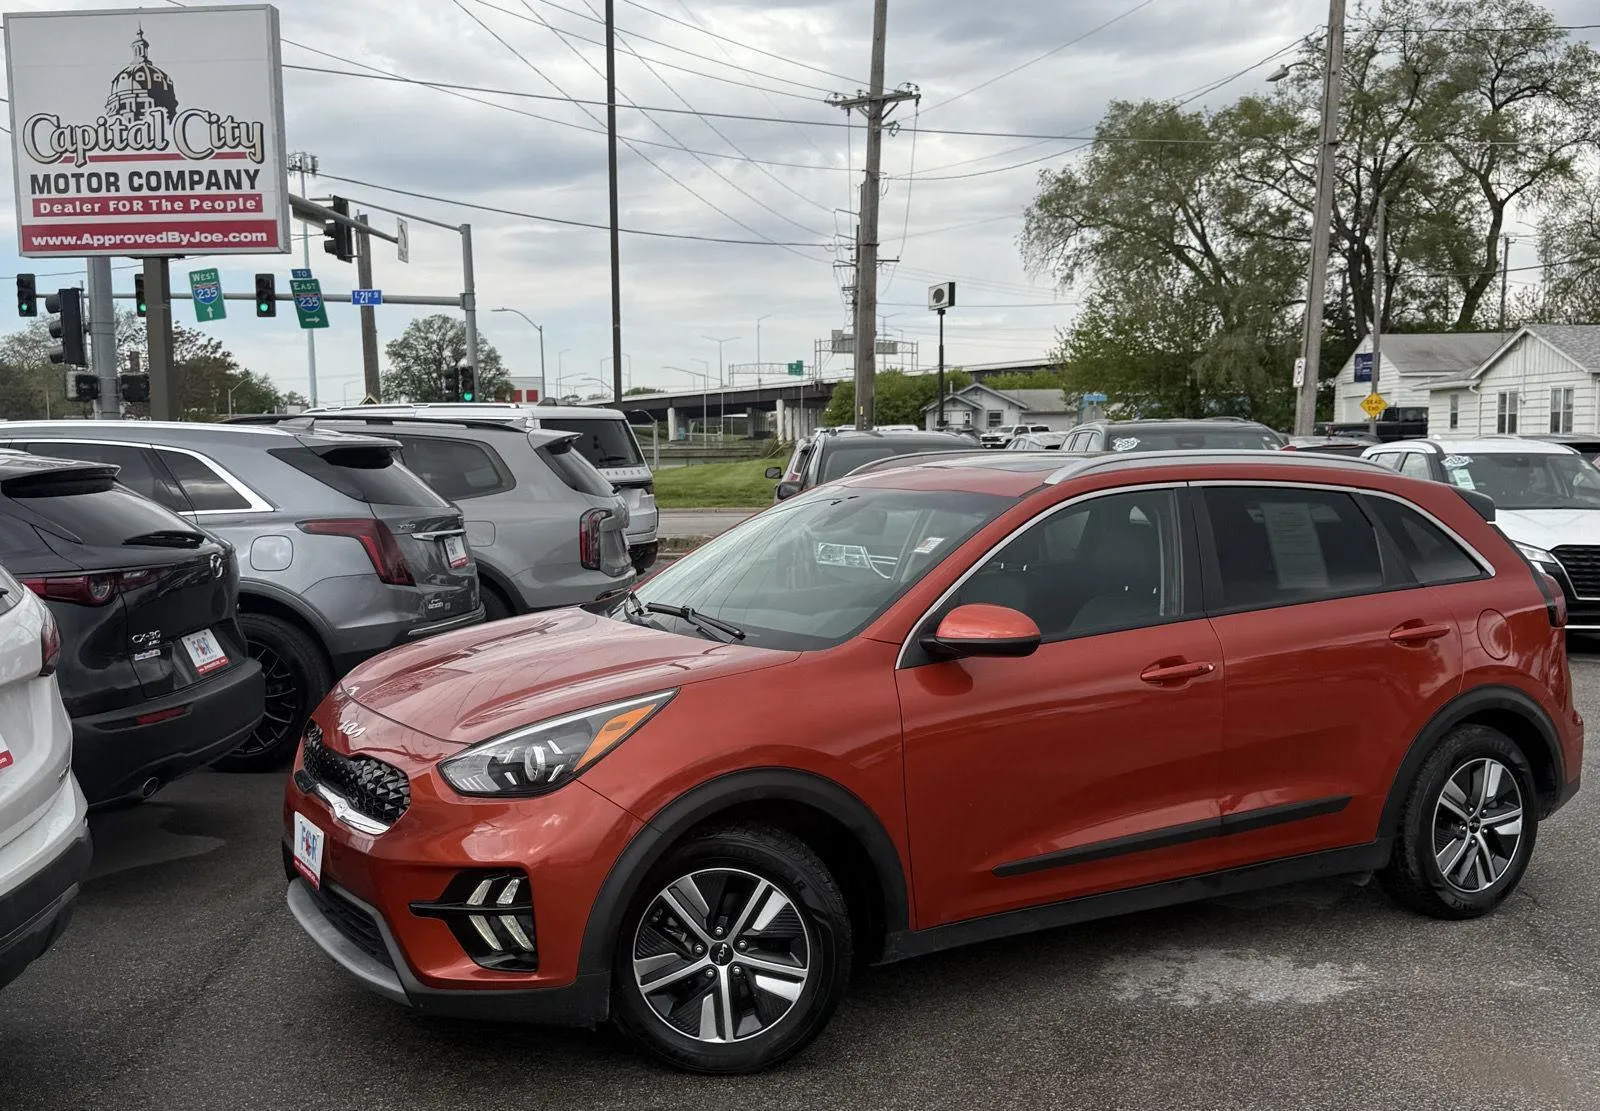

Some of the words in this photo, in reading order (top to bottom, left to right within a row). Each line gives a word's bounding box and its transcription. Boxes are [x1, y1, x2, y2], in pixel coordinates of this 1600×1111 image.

[23, 109, 169, 168] Capital
[173, 108, 265, 164] City
[30, 172, 120, 195] MOTOR
[128, 168, 260, 192] COMPANY
[40, 201, 101, 214] Dealer
[109, 200, 143, 212] FOR
[149, 199, 183, 212] The
[190, 197, 256, 212] People
[32, 231, 268, 247] www.ApprovedByJoe.com
[296, 270, 307, 278] TO
[197, 287, 218, 299] 235
[300, 297, 320, 308] 235
[132, 630, 161, 644] CX-30
